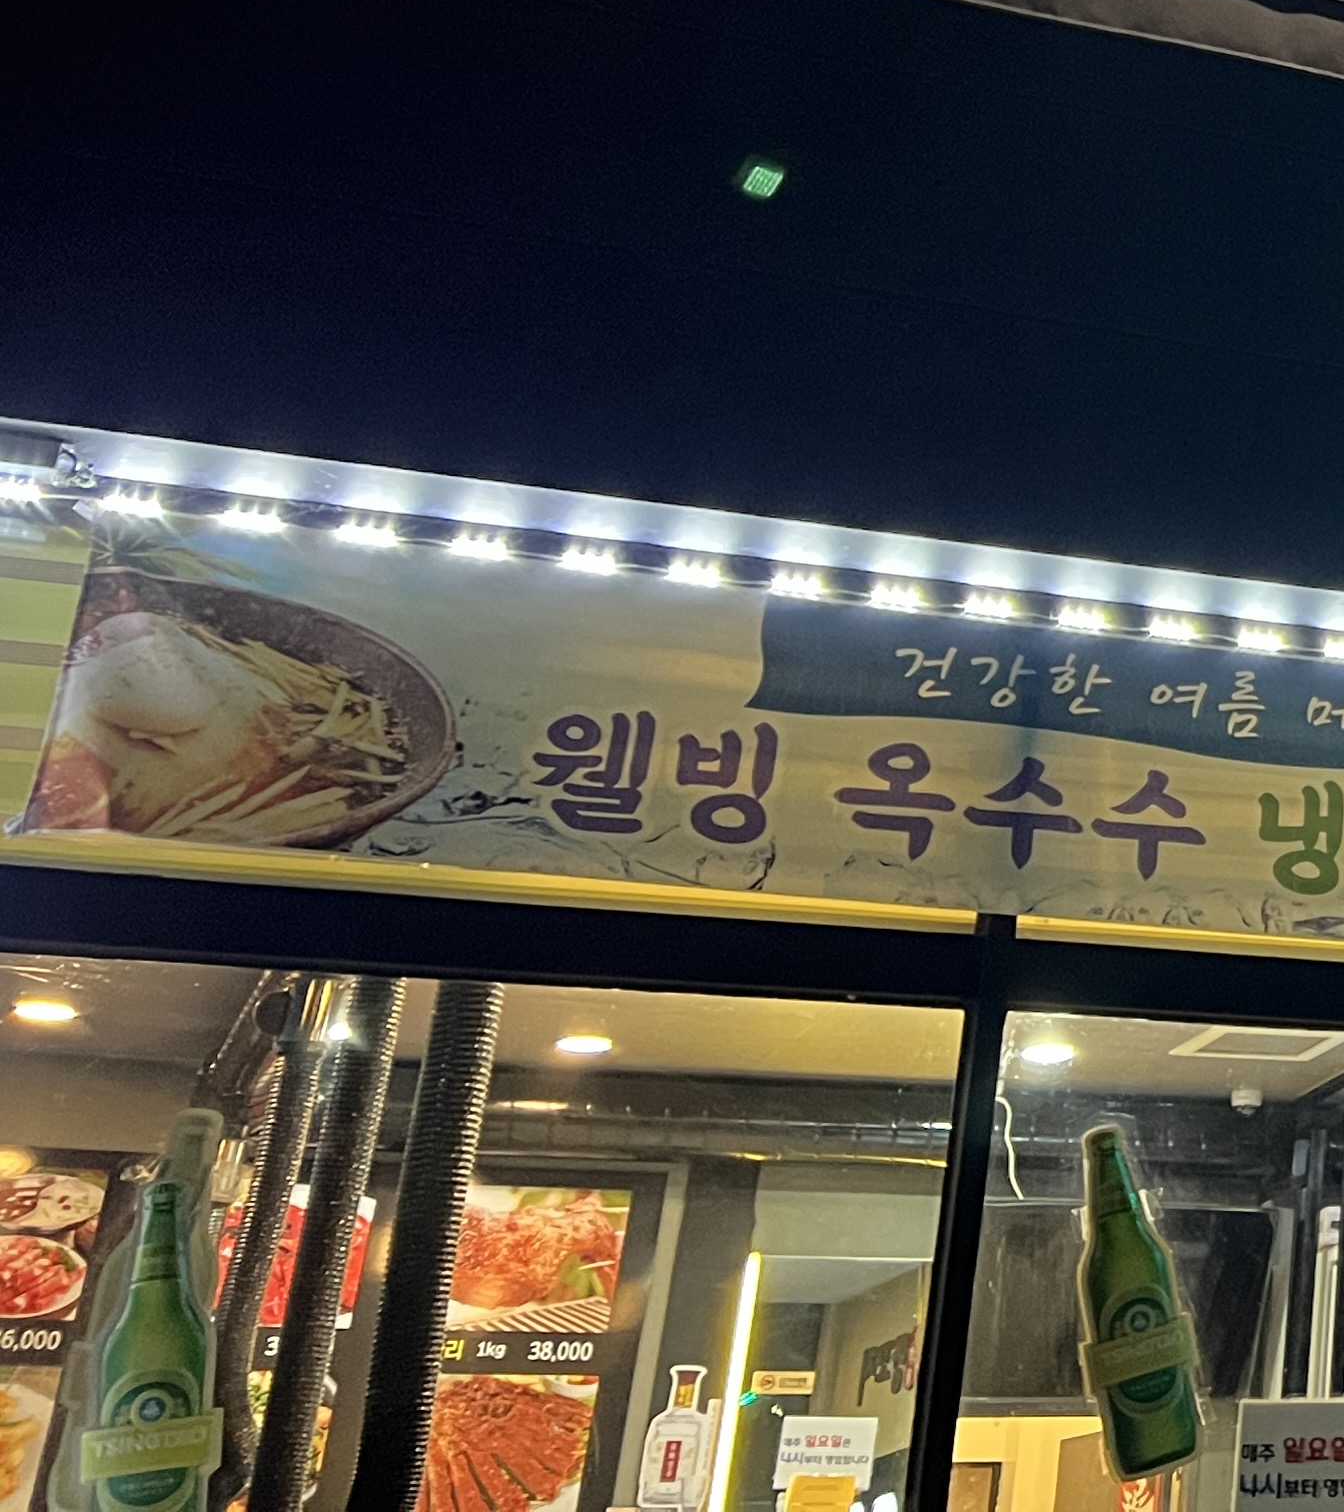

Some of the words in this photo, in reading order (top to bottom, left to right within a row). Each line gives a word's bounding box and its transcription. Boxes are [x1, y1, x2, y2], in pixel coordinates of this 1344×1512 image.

[896, 646, 1112, 715] 건강한
[1150, 670, 1266, 740] 여름
[533, 711, 779, 845] 웰빙
[835, 742, 1206, 880] 옥수수
[0, 1329, 62, 1352] 6,000
[476, 1340, 507, 1360] 1kg
[527, 1340, 594, 1363] 38,000
[1242, 1443, 1275, 1463] 매주
